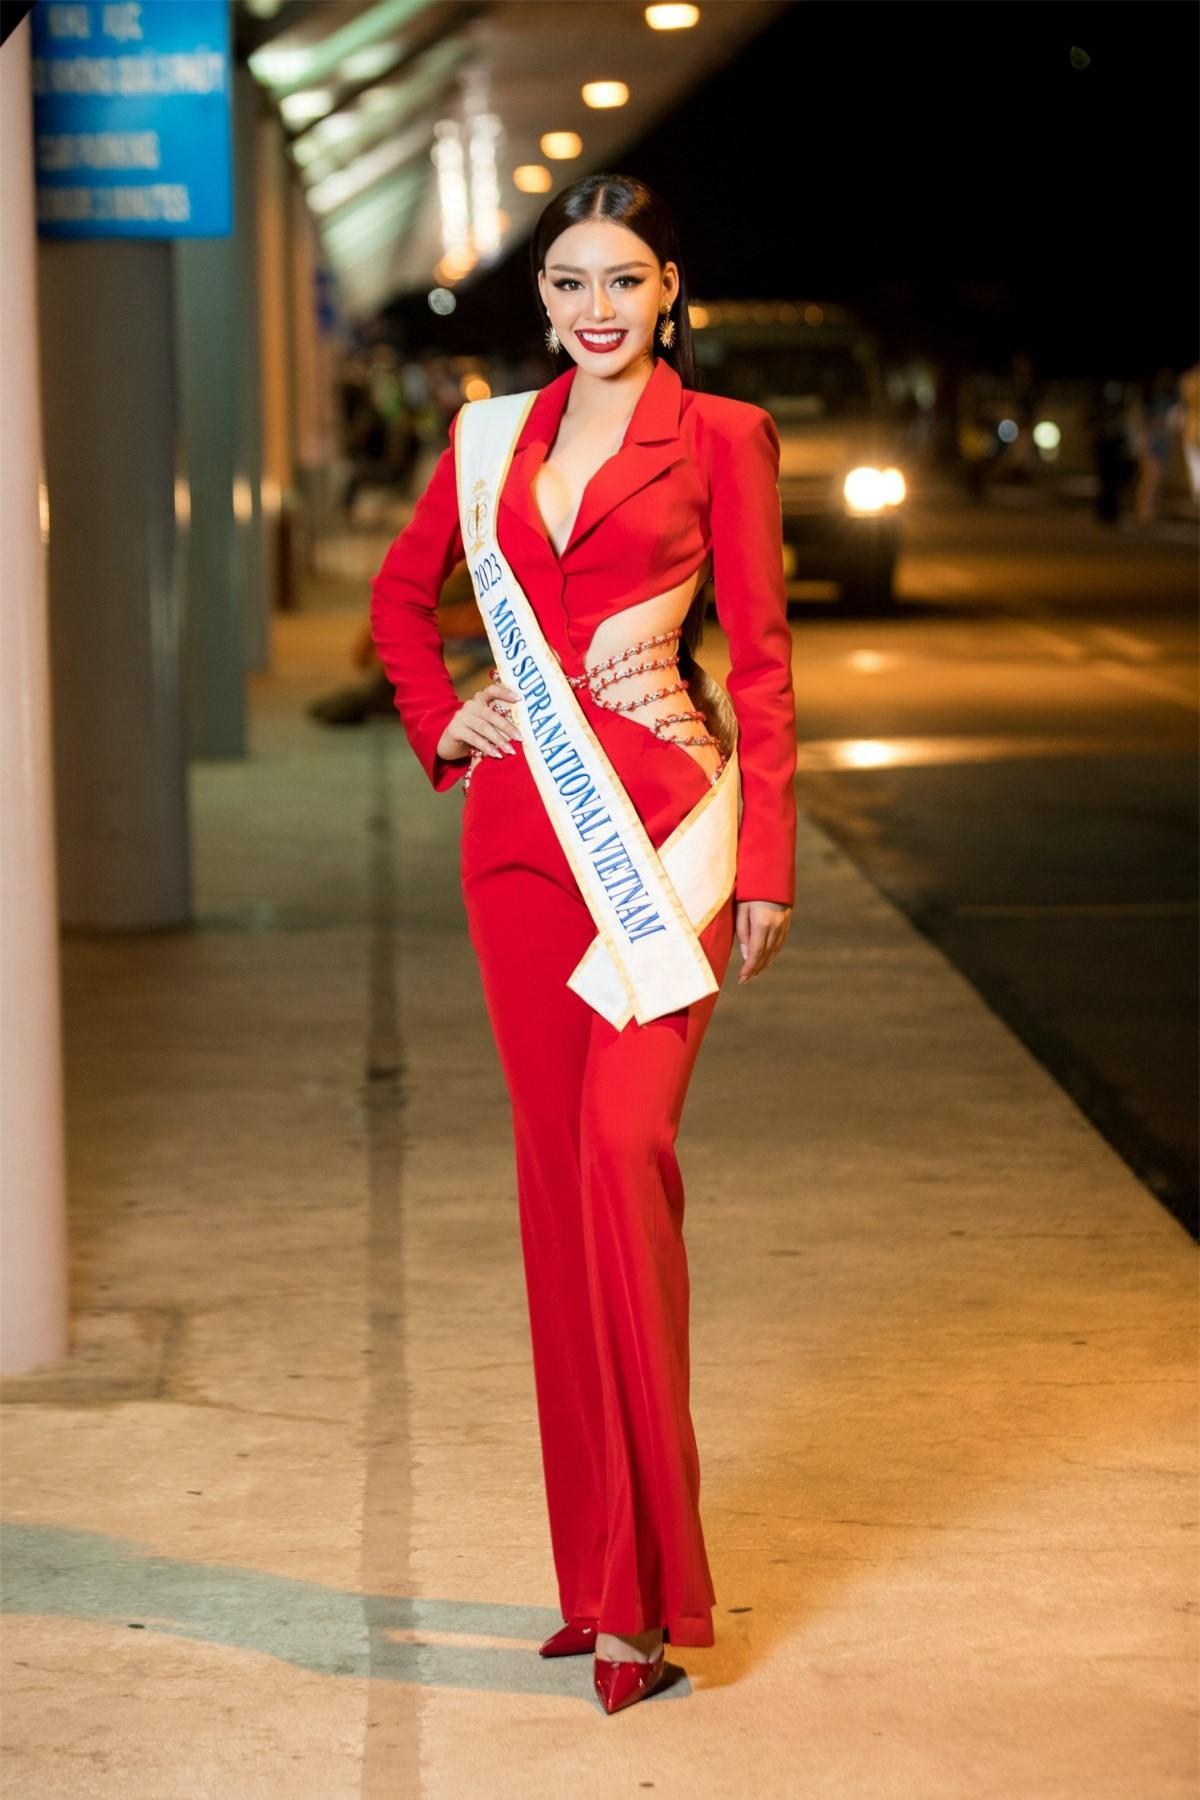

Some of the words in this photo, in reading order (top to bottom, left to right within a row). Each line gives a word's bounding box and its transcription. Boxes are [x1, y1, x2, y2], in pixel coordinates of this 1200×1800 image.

[474, 553, 503, 598] 2023
[489, 598, 527, 661] MISS
[512, 655, 613, 842] SUPRANATIONAL
[589, 831, 666, 944] VIETNAM
